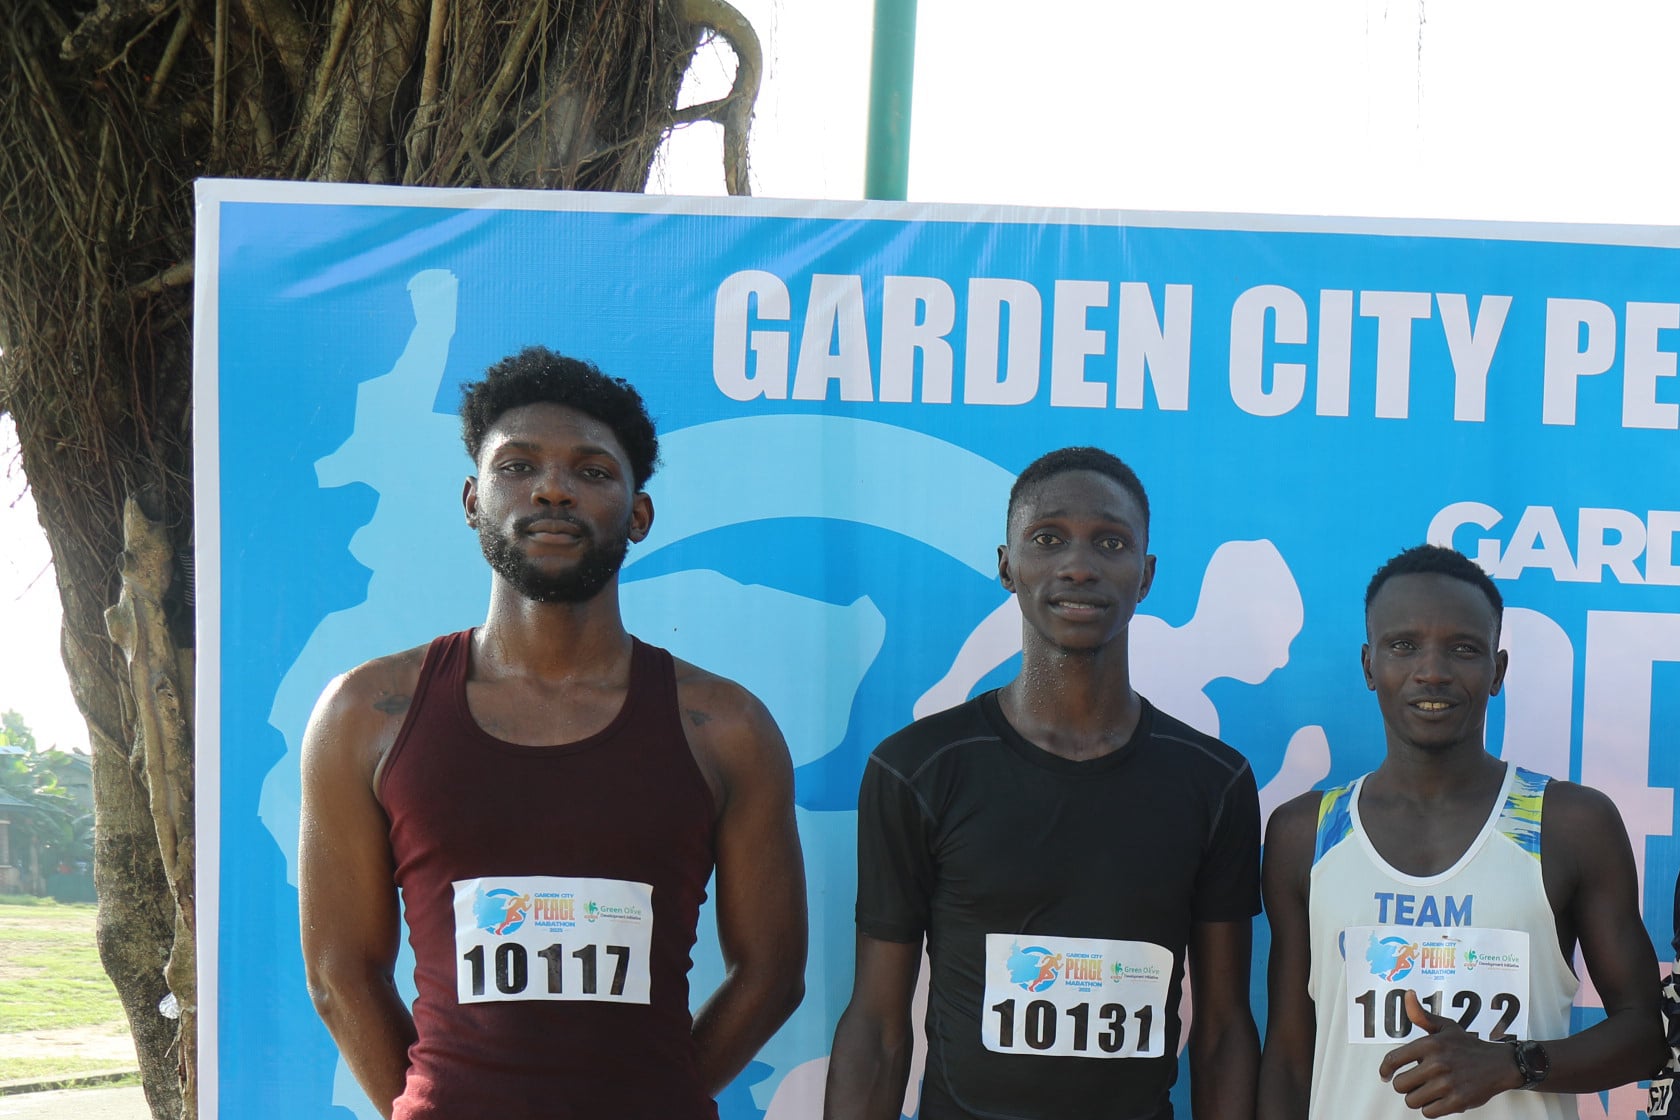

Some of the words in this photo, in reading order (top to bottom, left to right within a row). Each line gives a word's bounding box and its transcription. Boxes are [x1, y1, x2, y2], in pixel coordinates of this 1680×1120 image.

[713, 270, 1193, 411] GARDEN
[1228, 284, 1512, 423] CITY
[534, 899, 575, 921] PEACE
[600, 905, 623, 914] Green
[624, 905, 642, 915] Olive
[1374, 892, 1473, 927] TEAM
[464, 942, 631, 996] 10117
[1421, 947, 1456, 969] PEACE
[1479, 953, 1500, 962] Green
[1502, 953, 1520, 963] Olive
[1065, 959, 1103, 981] PEACE
[1143, 965, 1160, 974] Olive
[992, 999, 1153, 1053] 10131
